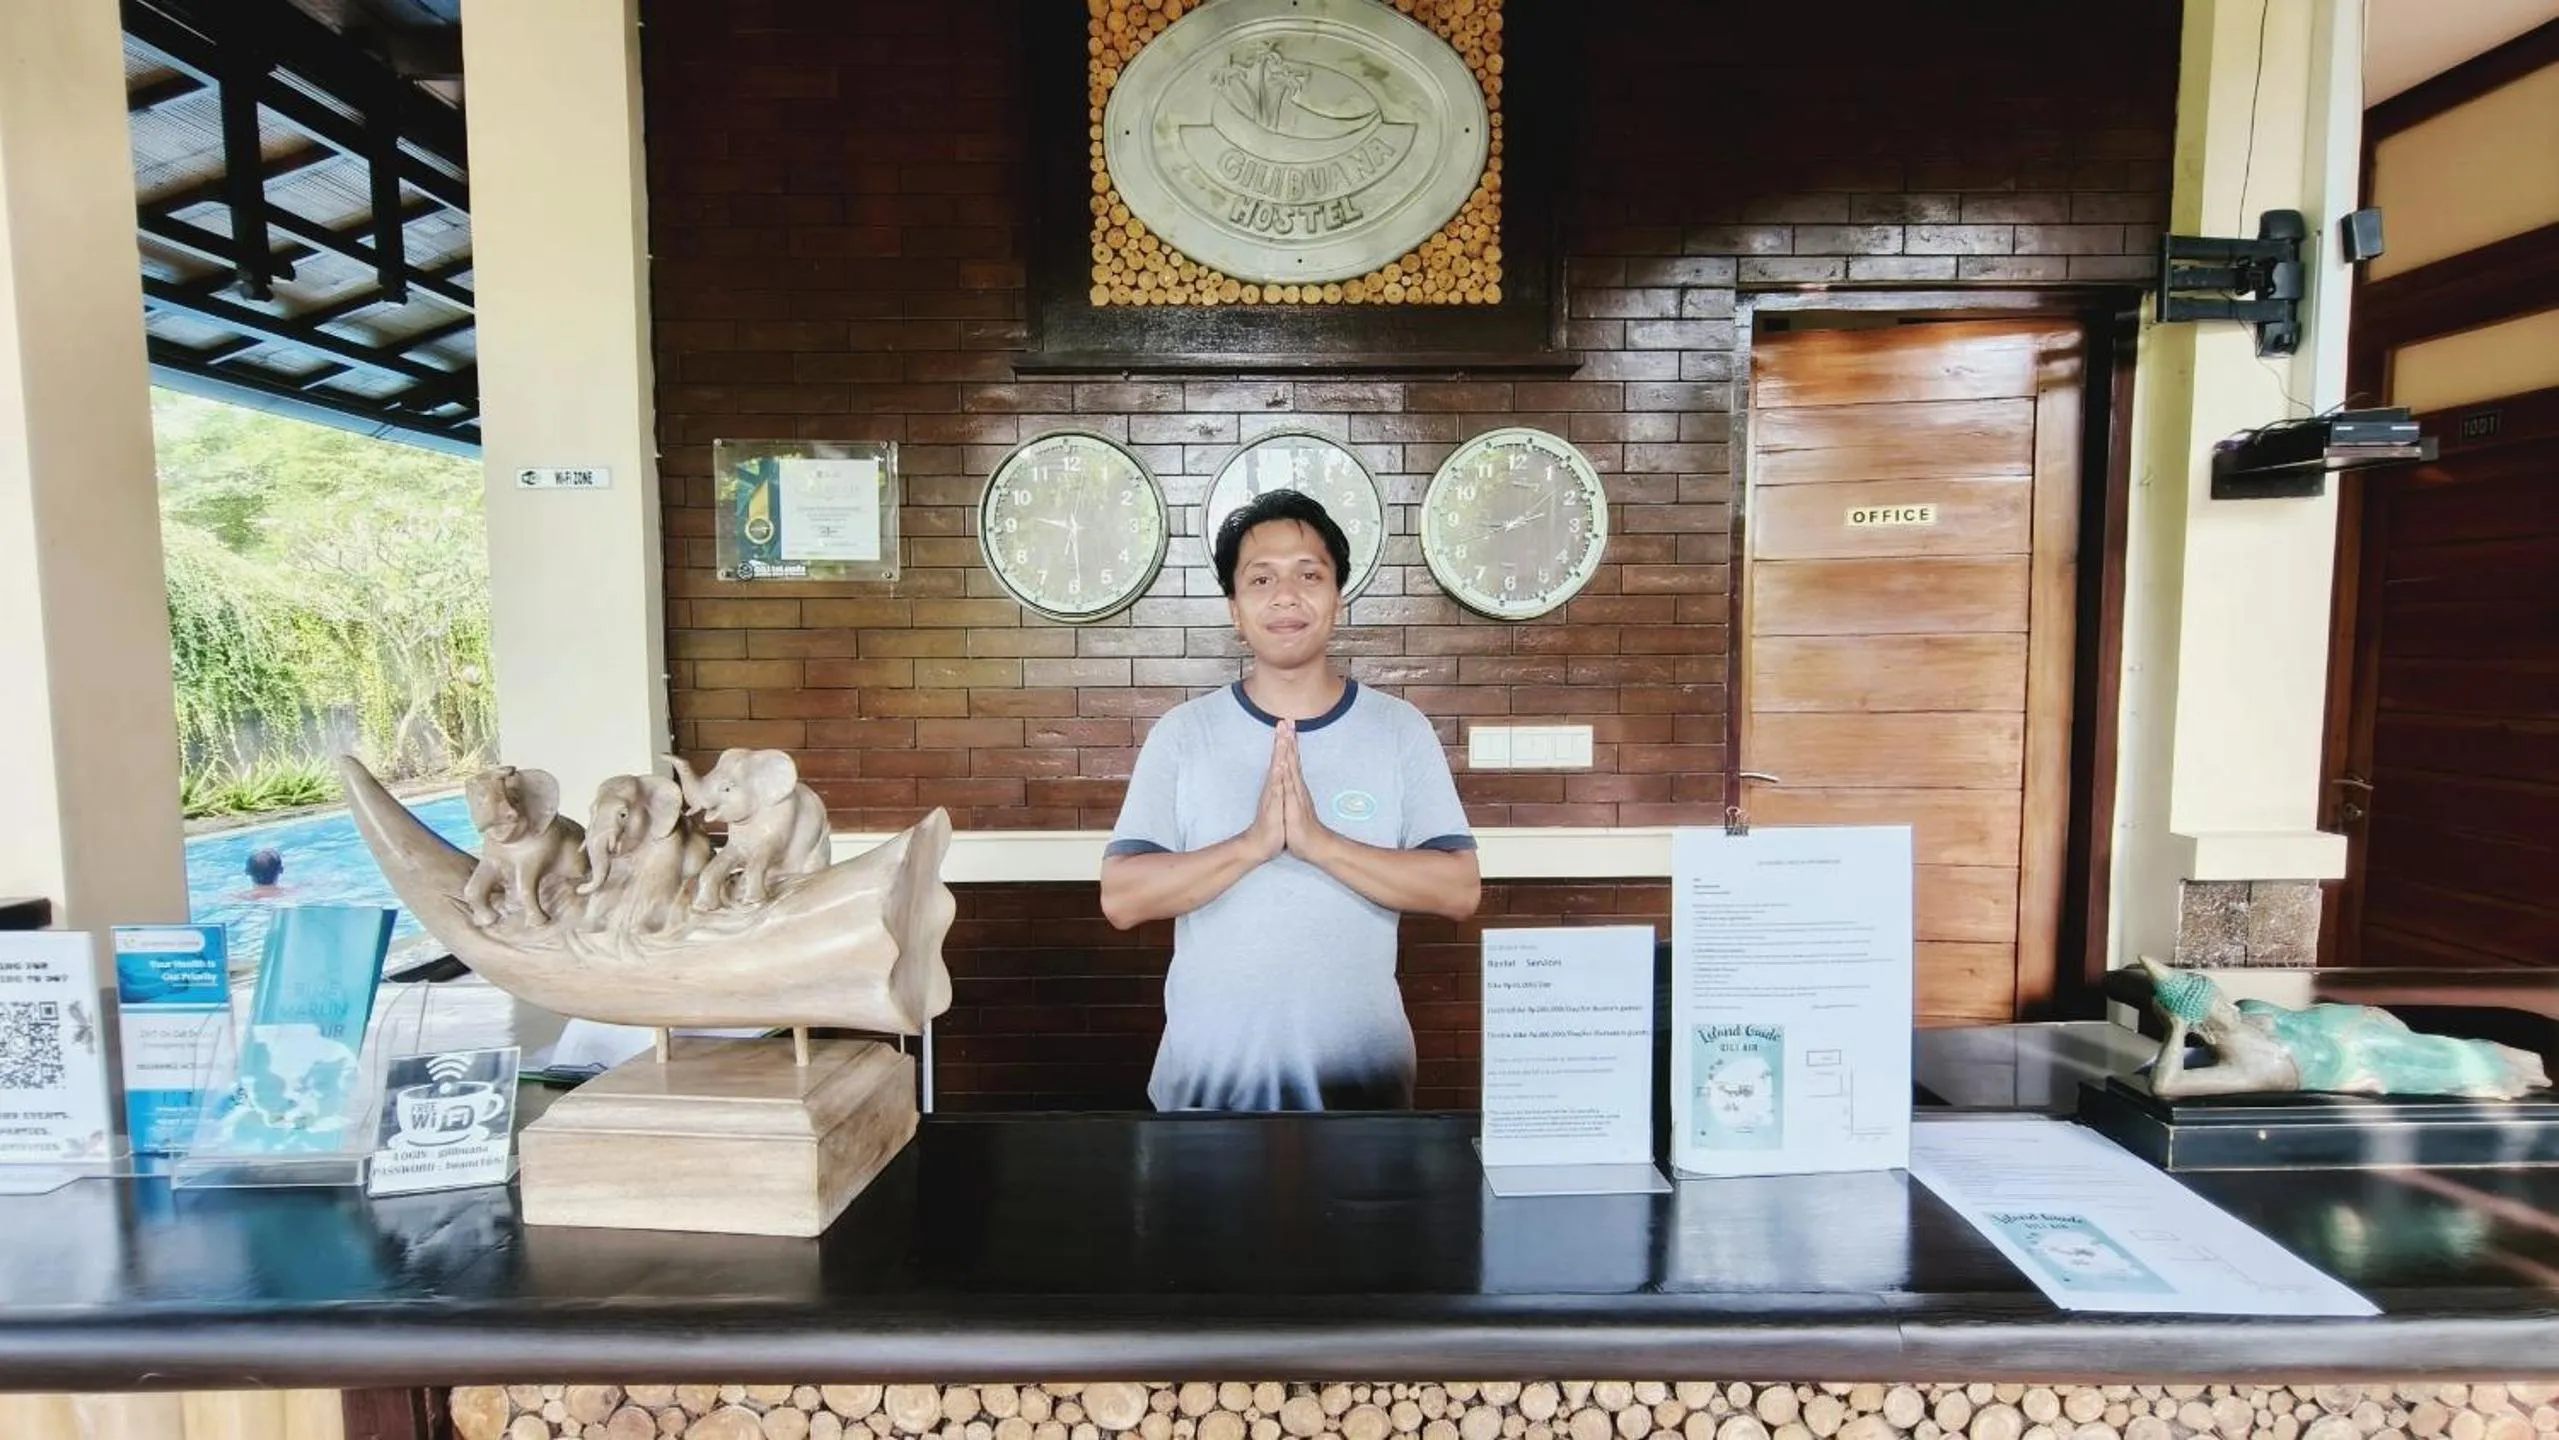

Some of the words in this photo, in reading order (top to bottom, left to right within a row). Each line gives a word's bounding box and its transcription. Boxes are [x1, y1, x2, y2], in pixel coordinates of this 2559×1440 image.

[1230, 194, 1365, 234] HOSTEL
[1062, 457, 1080, 472] 12
[1509, 454, 1527, 470] 12
[1033, 467, 1049, 482] 11
[1102, 467, 1108, 481] 1
[1478, 463, 1493, 478] 11
[1544, 465, 1553, 481] 1
[1014, 491, 1032, 506] 10
[1122, 491, 1133, 506] 2
[1343, 491, 1356, 506] 2
[1456, 485, 1476, 501] 10
[1564, 491, 1576, 506] 2
[1852, 508, 1930, 523] OFFICE
[1350, 521, 1361, 535] 3
[1569, 518, 1580, 533] 3
[1017, 549, 1027, 564] 8
[1118, 549, 1129, 564] 4
[1456, 545, 1467, 559] 8
[1556, 549, 1568, 564] 4
[1037, 570, 1048, 585] 7
[1101, 569, 1112, 584] 5
[1474, 565, 1487, 581] 7
[1504, 575, 1515, 591] 6
[180, 971, 218, 984] Priority
[1697, 1024, 1741, 1044] Island
[1744, 1024, 1782, 1041] Guide
